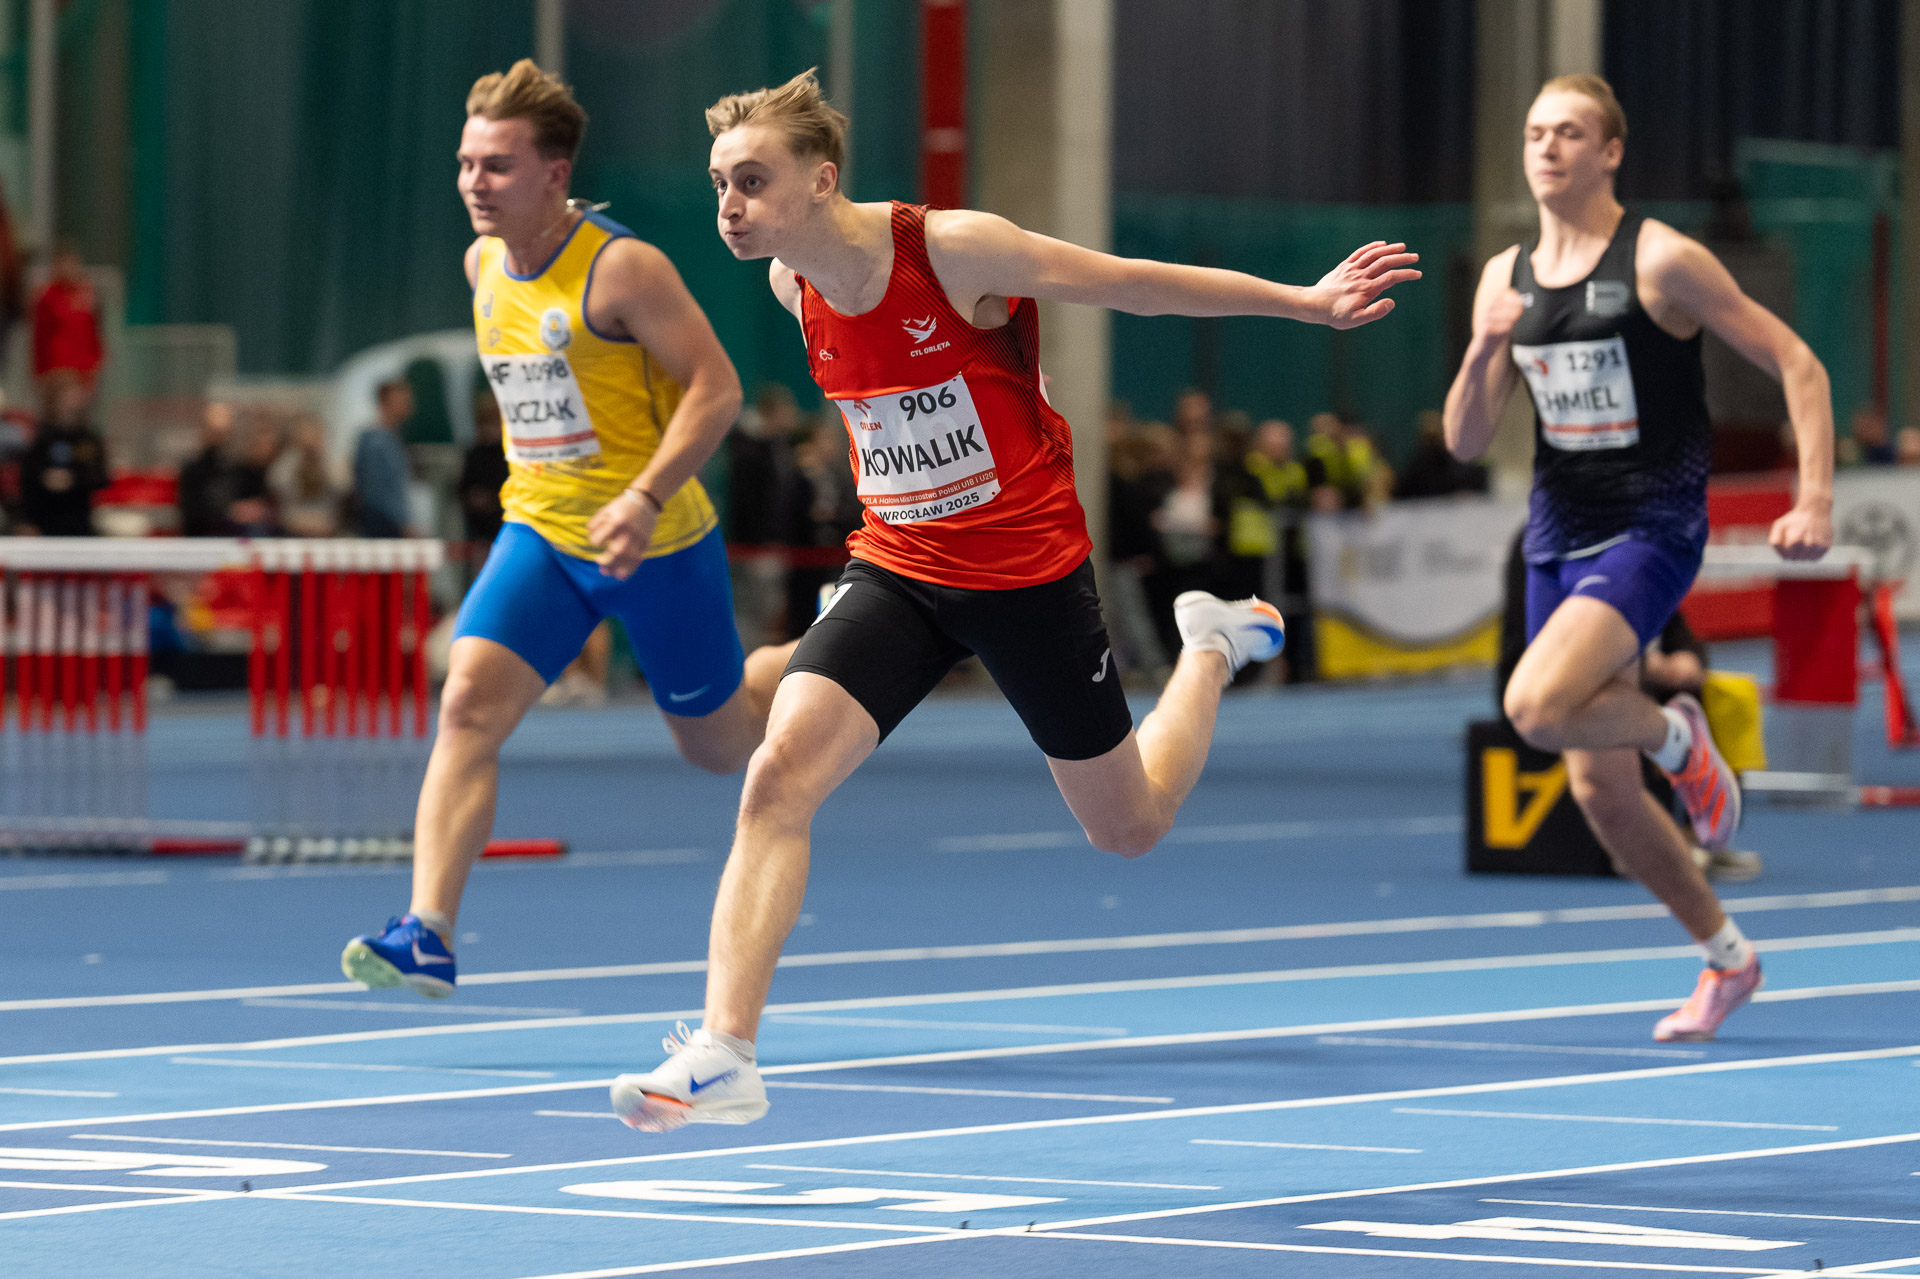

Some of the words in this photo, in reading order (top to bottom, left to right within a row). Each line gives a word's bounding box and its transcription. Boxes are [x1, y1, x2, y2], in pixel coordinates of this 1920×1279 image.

[910, 347, 923, 358] CTL
[924, 340, 951, 355] ORLĘTA
[1567, 346, 1621, 372] 1291
[521, 358, 569, 381] 1098
[899, 385, 957, 421] 906
[859, 421, 883, 431] ORLEN
[861, 424, 985, 477] KOWALIK
[938, 483, 961, 497] Polski
[961, 479, 975, 489] U18
[979, 471, 994, 482] U20
[879, 504, 944, 521] WROCŁAW
[946, 492, 980, 512] 2025
